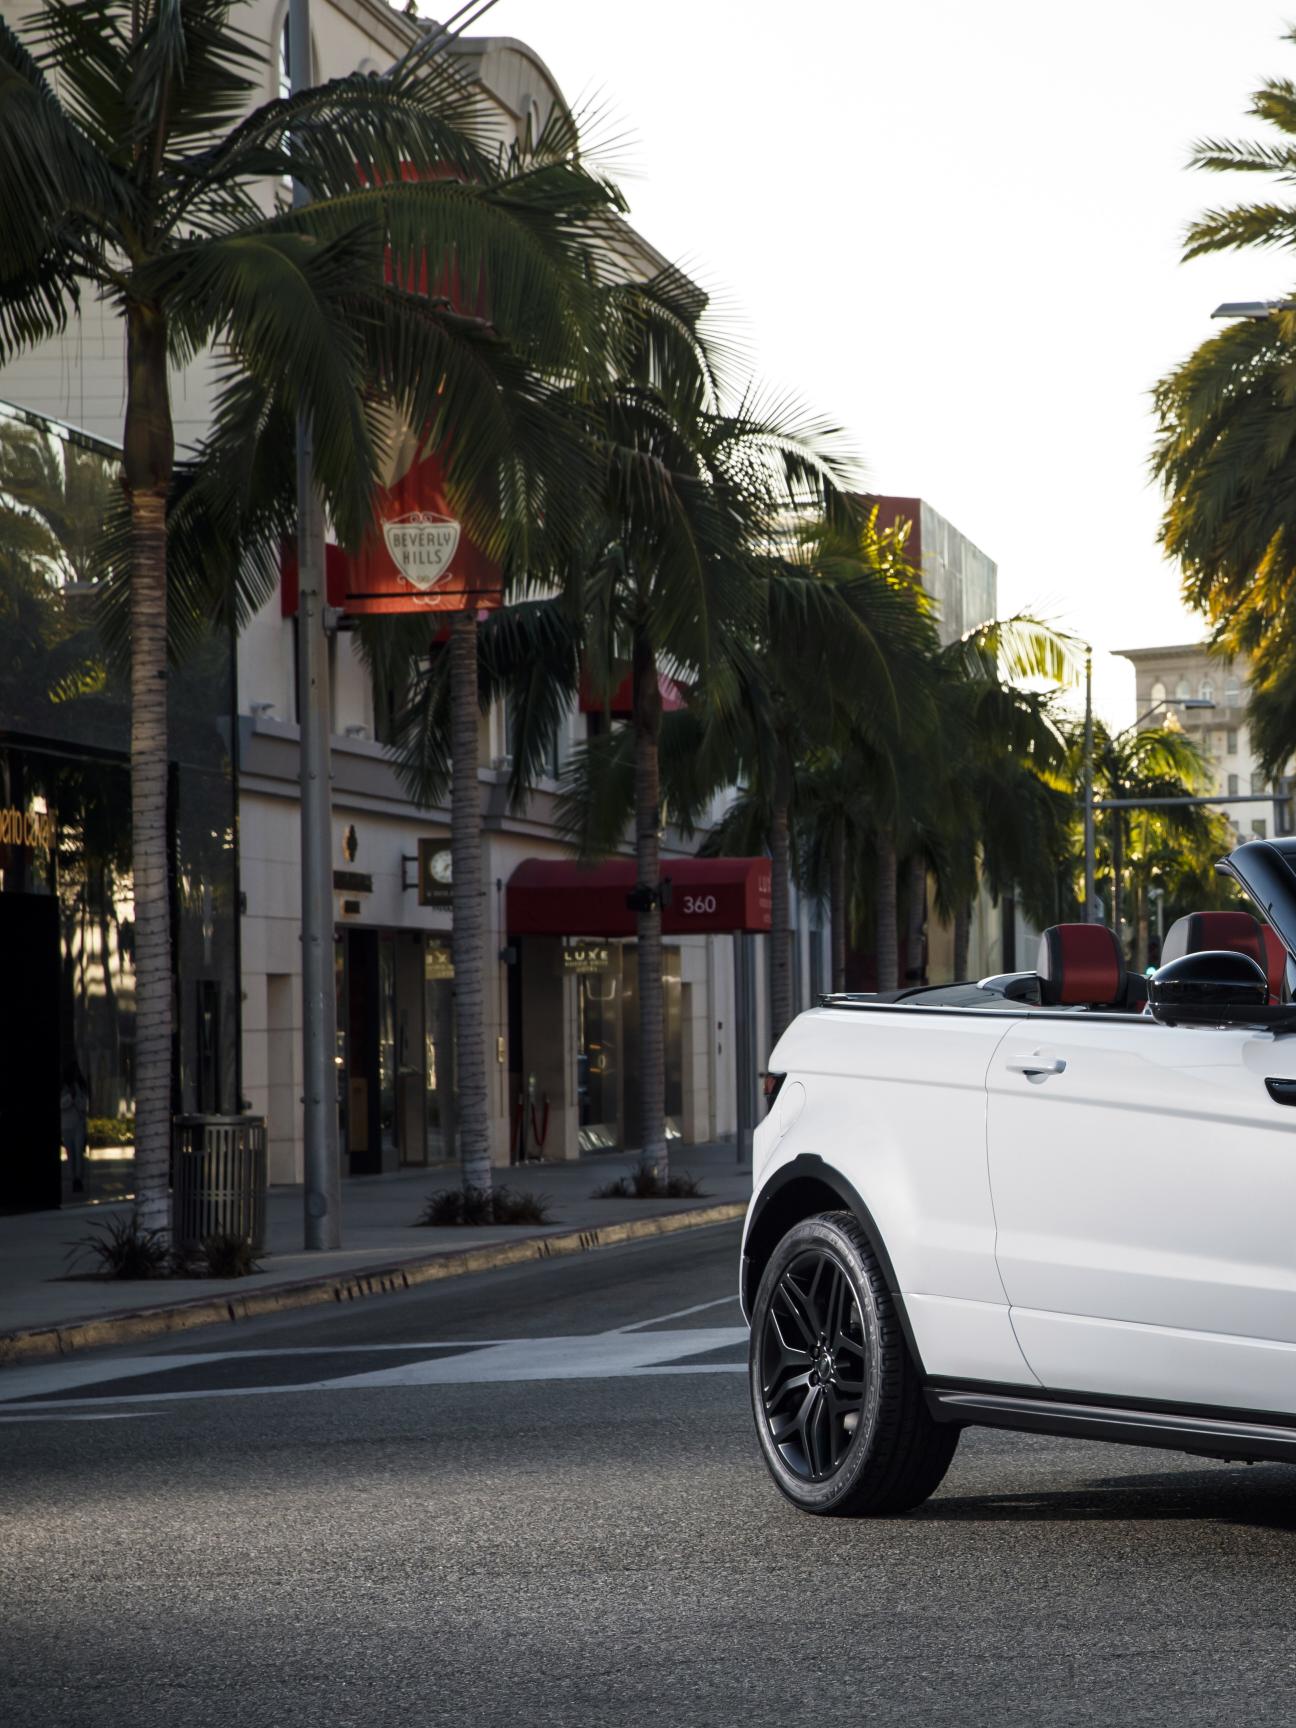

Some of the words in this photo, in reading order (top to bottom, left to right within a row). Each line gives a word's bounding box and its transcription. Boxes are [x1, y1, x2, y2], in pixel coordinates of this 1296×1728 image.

[393, 531, 452, 548] BEVERLY
[402, 549, 443, 565] HILLS
[683, 895, 717, 914] 360
[564, 948, 609, 961] LUXE
